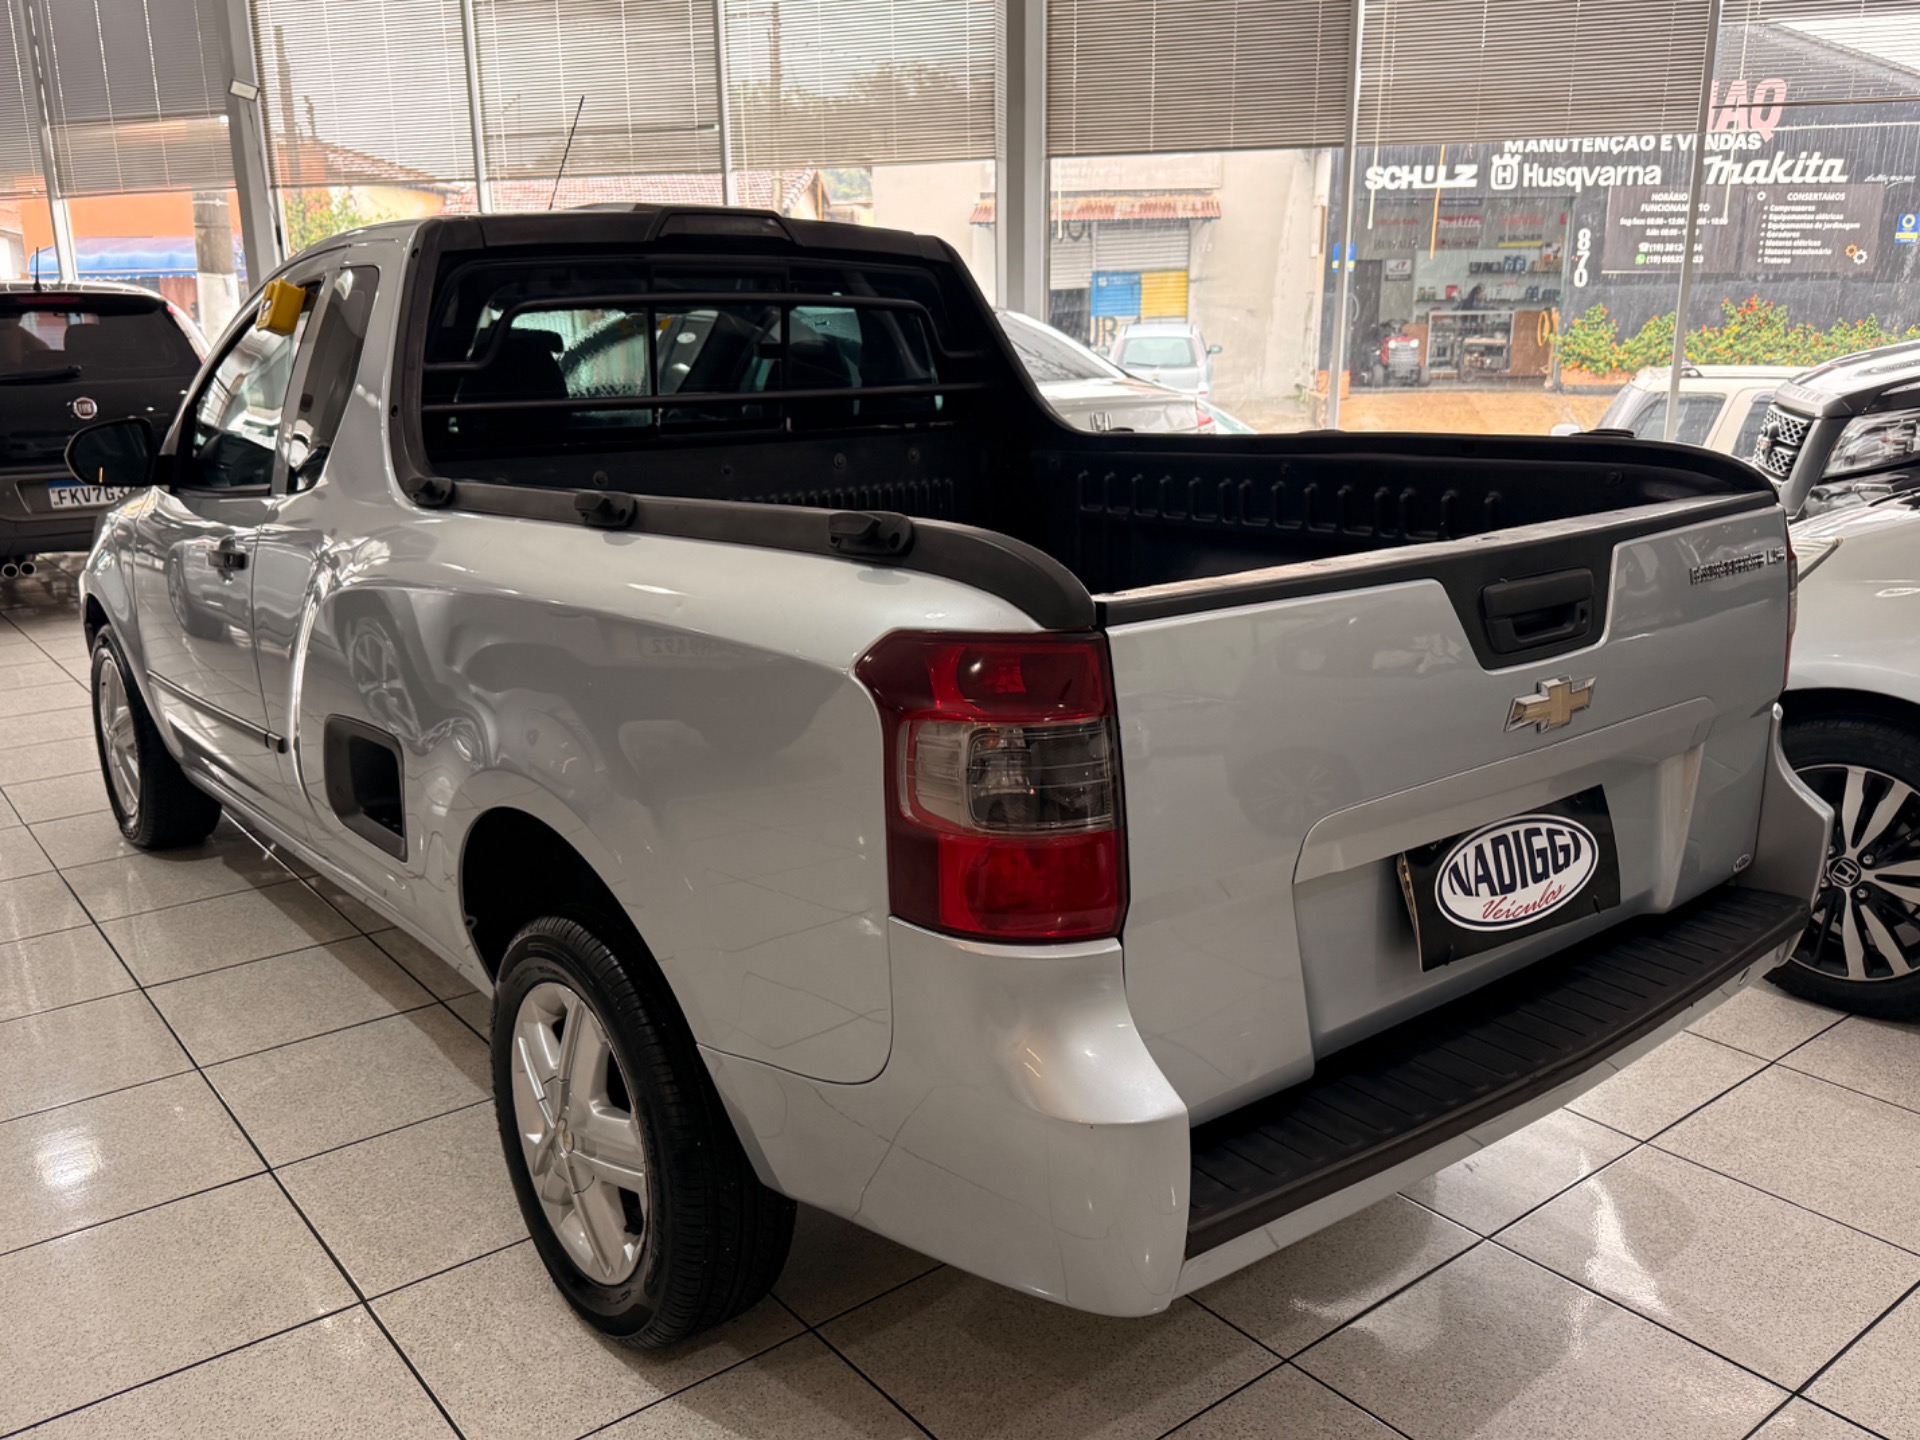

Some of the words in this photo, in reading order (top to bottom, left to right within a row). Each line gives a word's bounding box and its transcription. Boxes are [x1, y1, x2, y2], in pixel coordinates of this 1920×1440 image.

[1660, 134, 1672, 151] E
[1679, 133, 1762, 151] VNDAS
[1365, 163, 1478, 190] SCHULZ
[1523, 162, 1661, 192] Husqvarna
[1786, 191, 1846, 201] CONSERTAMOS
[1450, 827, 1582, 897] NADIGGI
